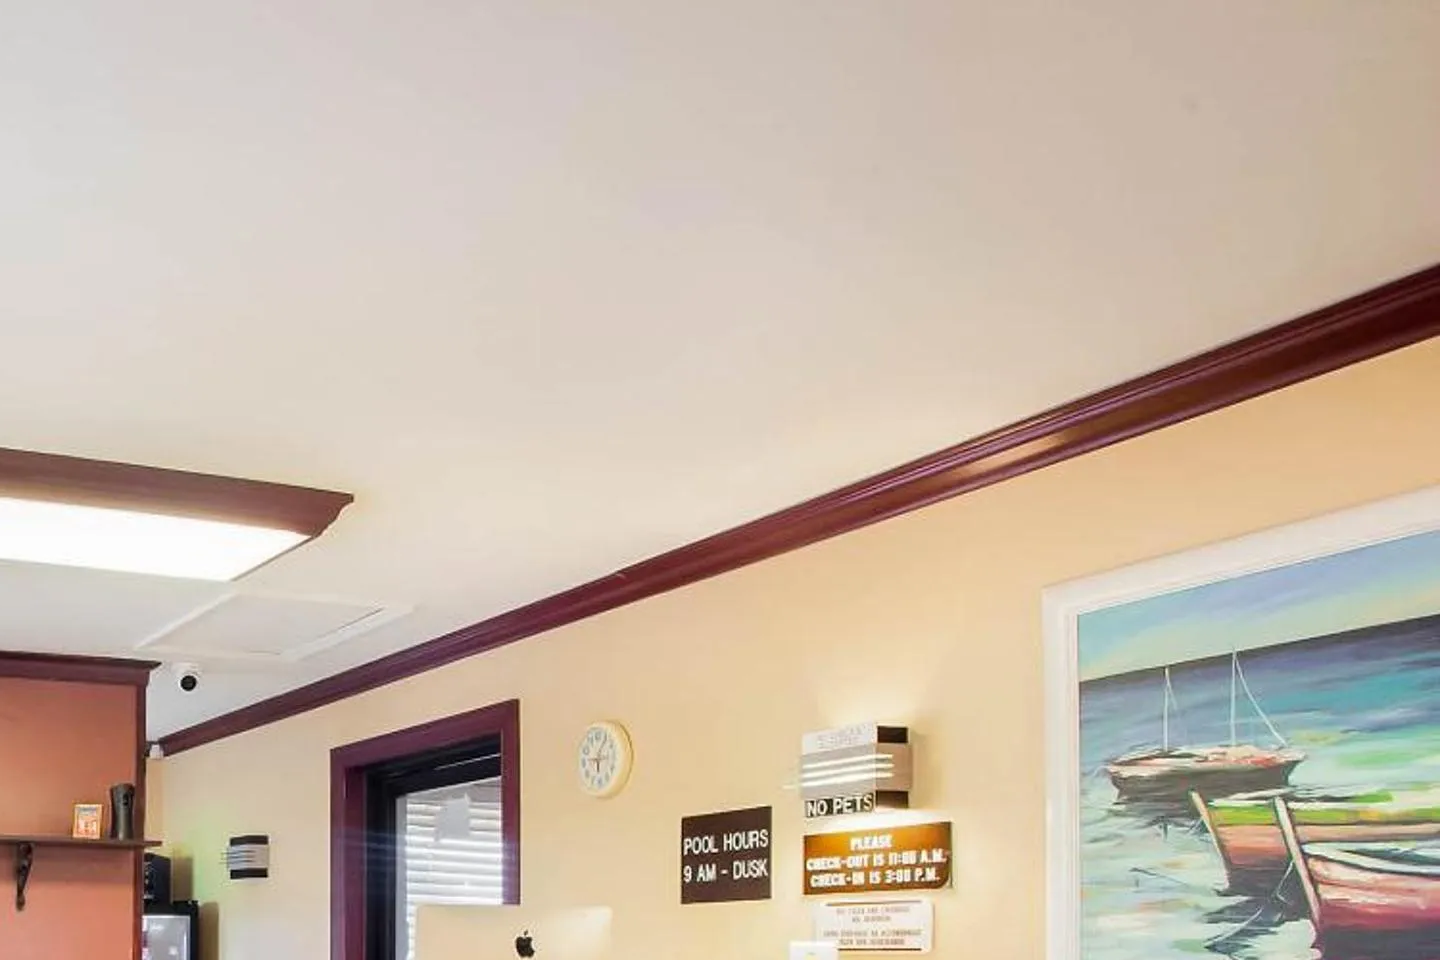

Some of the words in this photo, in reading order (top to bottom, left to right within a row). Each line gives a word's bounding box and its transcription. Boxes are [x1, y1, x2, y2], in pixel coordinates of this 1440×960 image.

[807, 799, 828, 817] NO
[833, 793, 873, 814] PETS
[683, 835, 719, 856] POOL
[723, 829, 769, 851] HOURS
[850, 834, 893, 850] PLEASE
[683, 865, 692, 883] 9
[696, 863, 717, 882] AM
[733, 858, 768, 880] DUSK
[806, 853, 869, 871] CHECK-OUT
[873, 852, 885, 867] IS
[920, 848, 947, 863] A.M.
[810, 871, 865, 888] CHECK-IN
[869, 870, 881, 884] IS
[914, 867, 940, 882] P.M.
